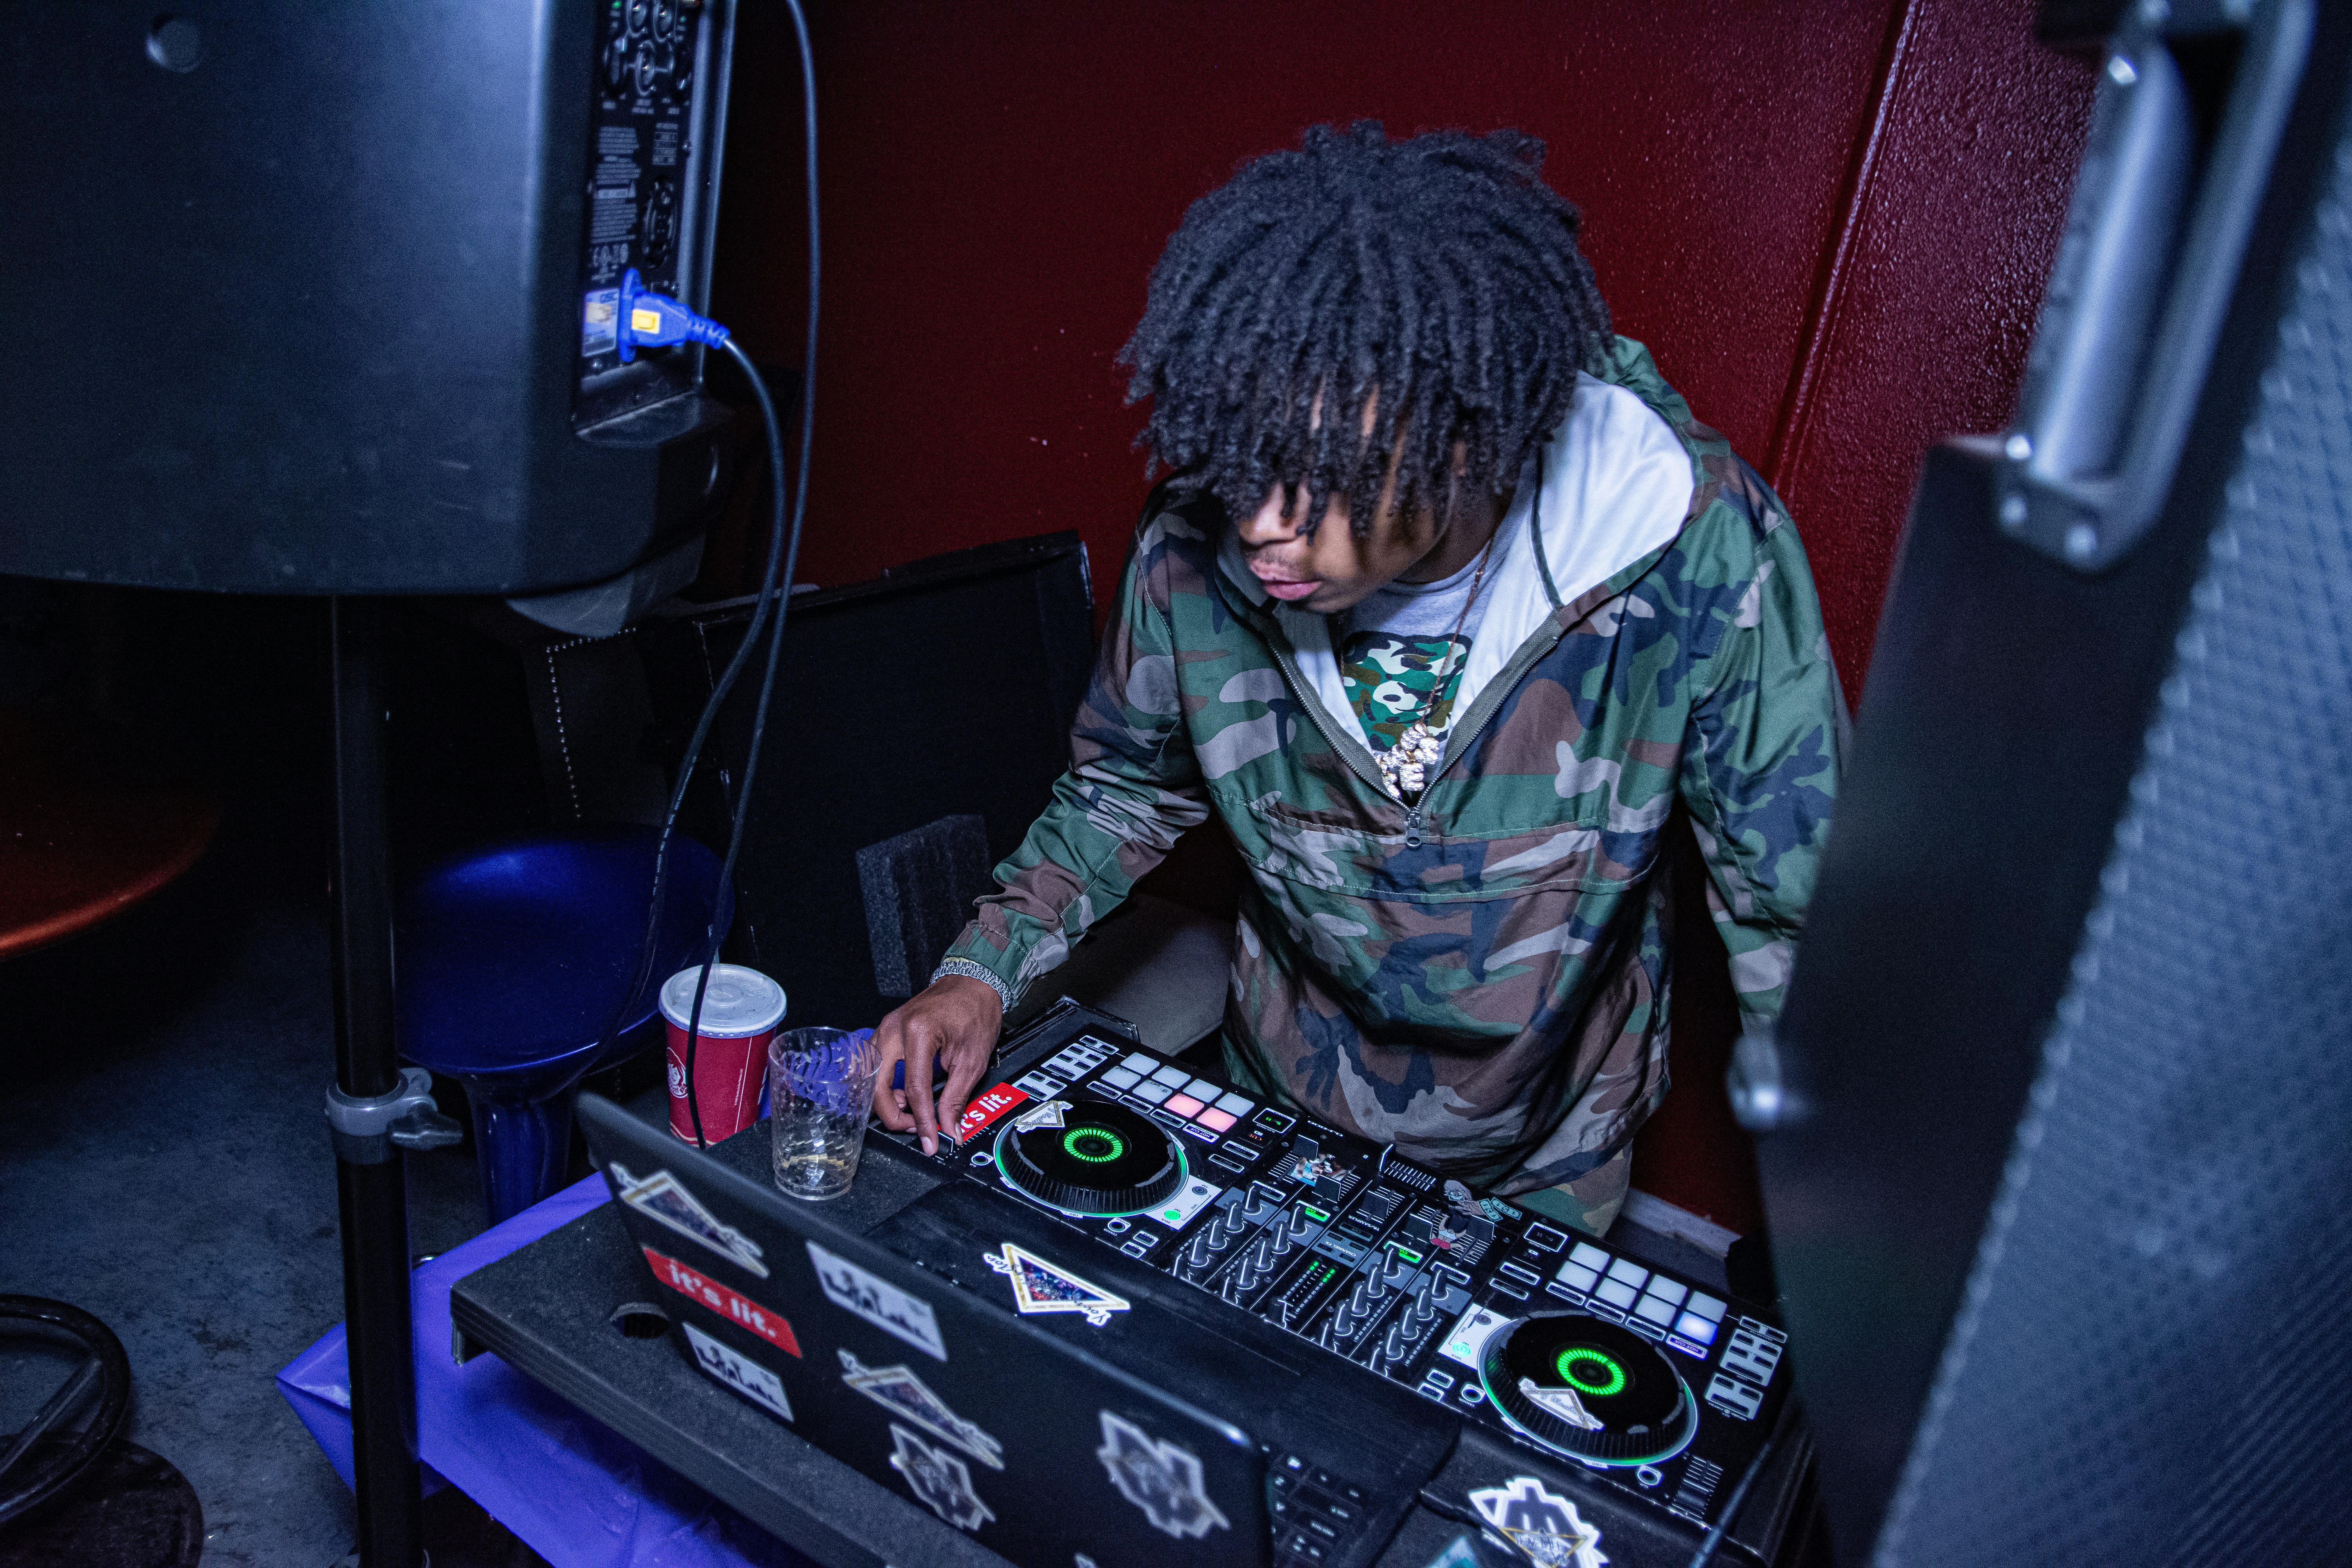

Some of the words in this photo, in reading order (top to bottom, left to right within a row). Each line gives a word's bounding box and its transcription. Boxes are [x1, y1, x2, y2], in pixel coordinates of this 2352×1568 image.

[978, 1093, 1012, 1113] lit.
[1256, 1123, 1276, 1133] PLAY/PAUSE
[1348, 1214, 1380, 1231] TR/SAMPLER
[1103, 1228, 1117, 1236] CENSOR
[1332, 1244, 1356, 1257] CHANNEL
[1528, 1240, 1550, 1252] PLAY/PAUSE
[669, 1258, 722, 1307] it's
[730, 1297, 776, 1338] lit.
[1066, 1293, 1108, 1325] Young
[1673, 1339, 1686, 1347] CUE
[1686, 1345, 1699, 1353] HOT
[1468, 1384, 1484, 1393] REVERSE
[1457, 1397, 1475, 1407] CENSOR
[1730, 1412, 1747, 1421] serato
